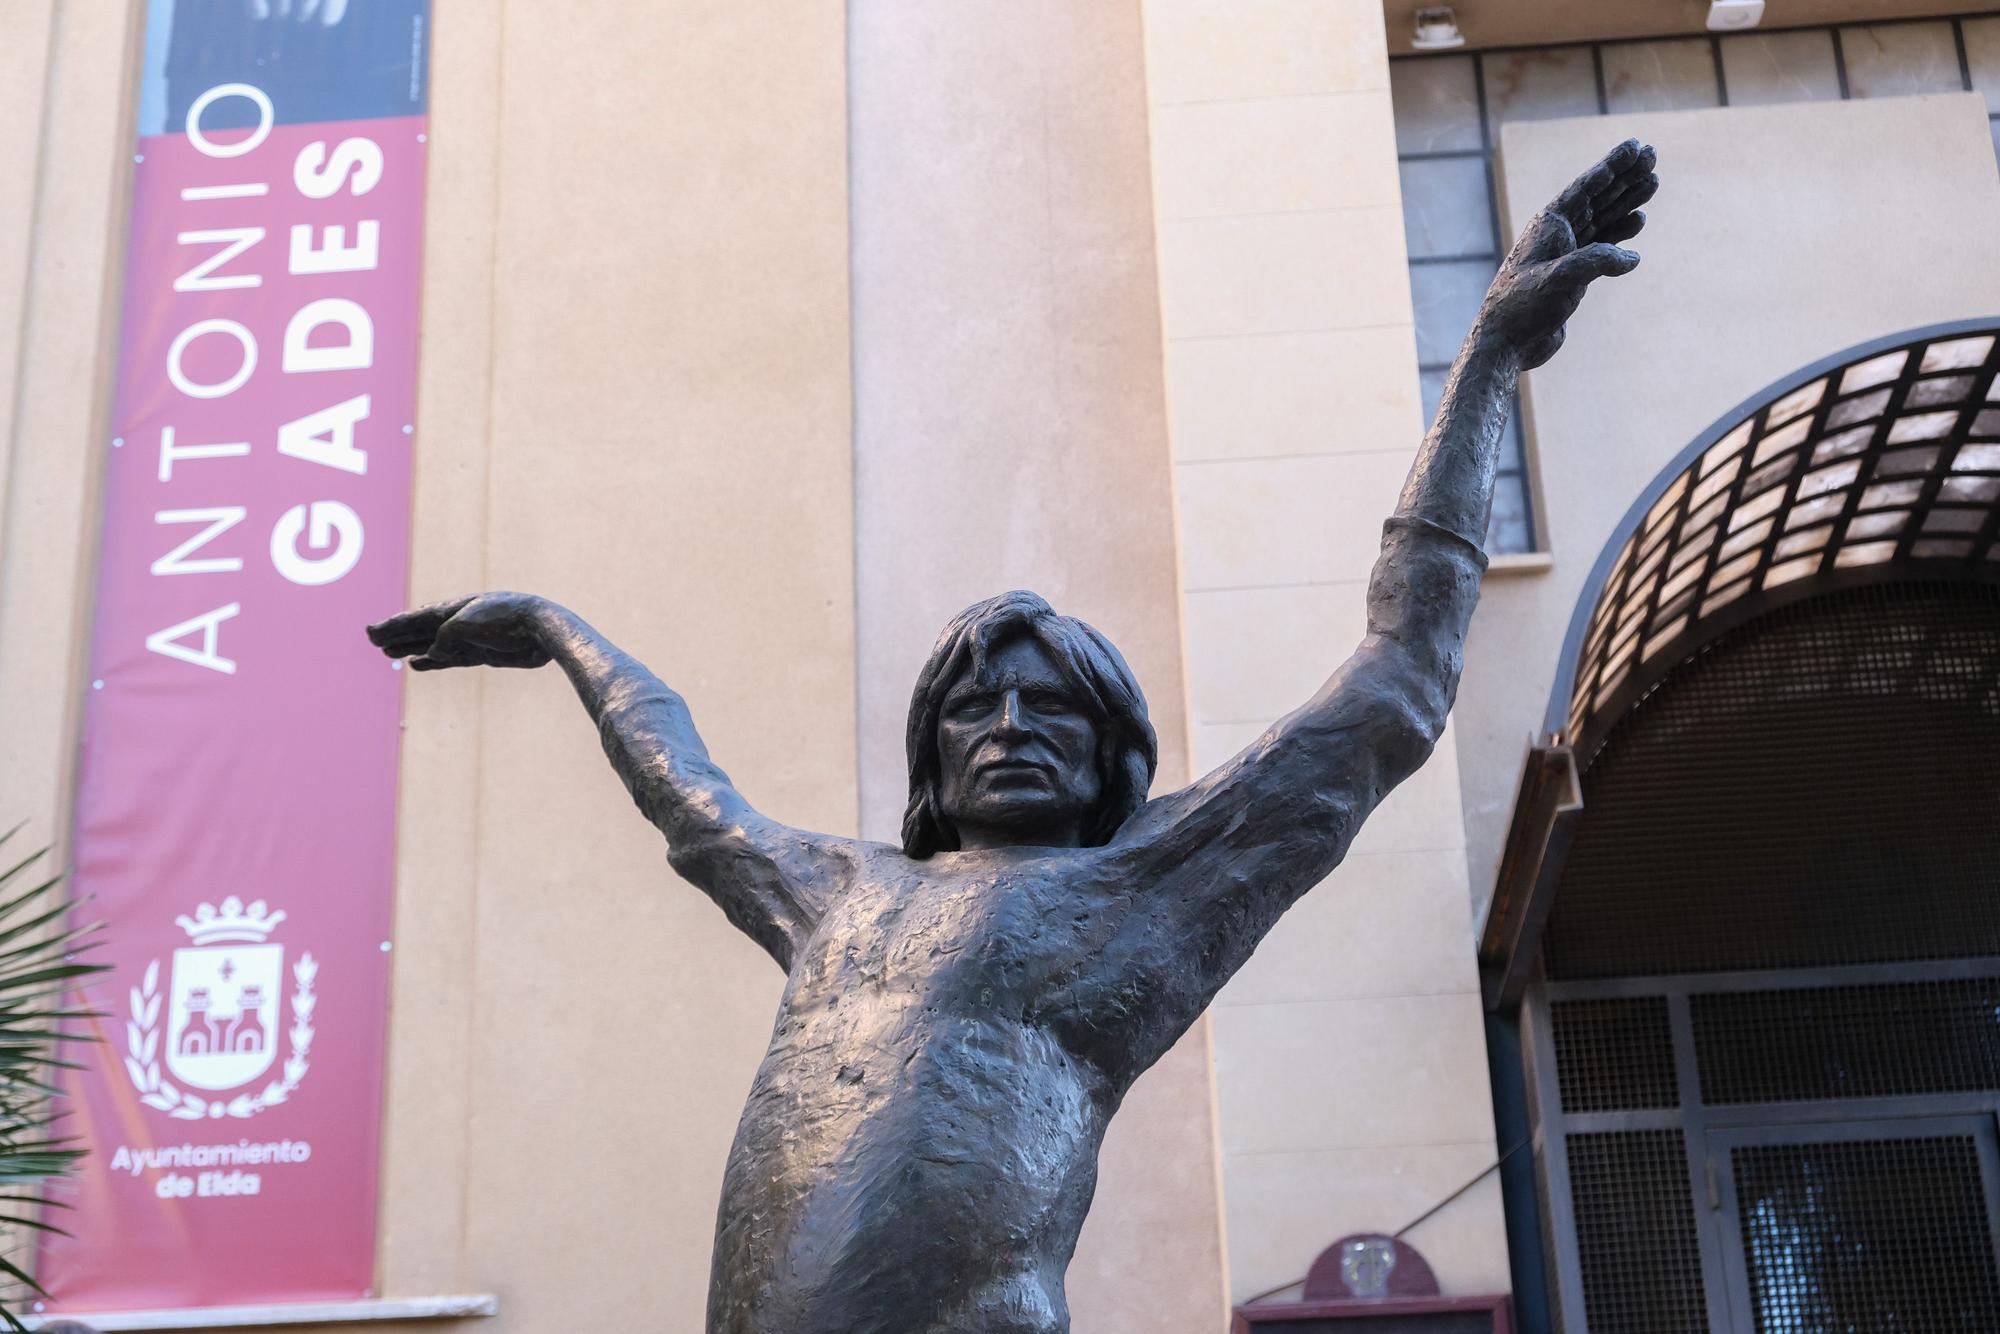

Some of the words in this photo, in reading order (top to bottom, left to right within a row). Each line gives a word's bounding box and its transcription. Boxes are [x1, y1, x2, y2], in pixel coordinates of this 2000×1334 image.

[146, 82, 275, 674] ANTONIO
[270, 137, 384, 586] GADES
[111, 1139, 311, 1176] Ayuntamiento
[156, 1173, 194, 1198] de
[198, 1172, 261, 1197] Elda
